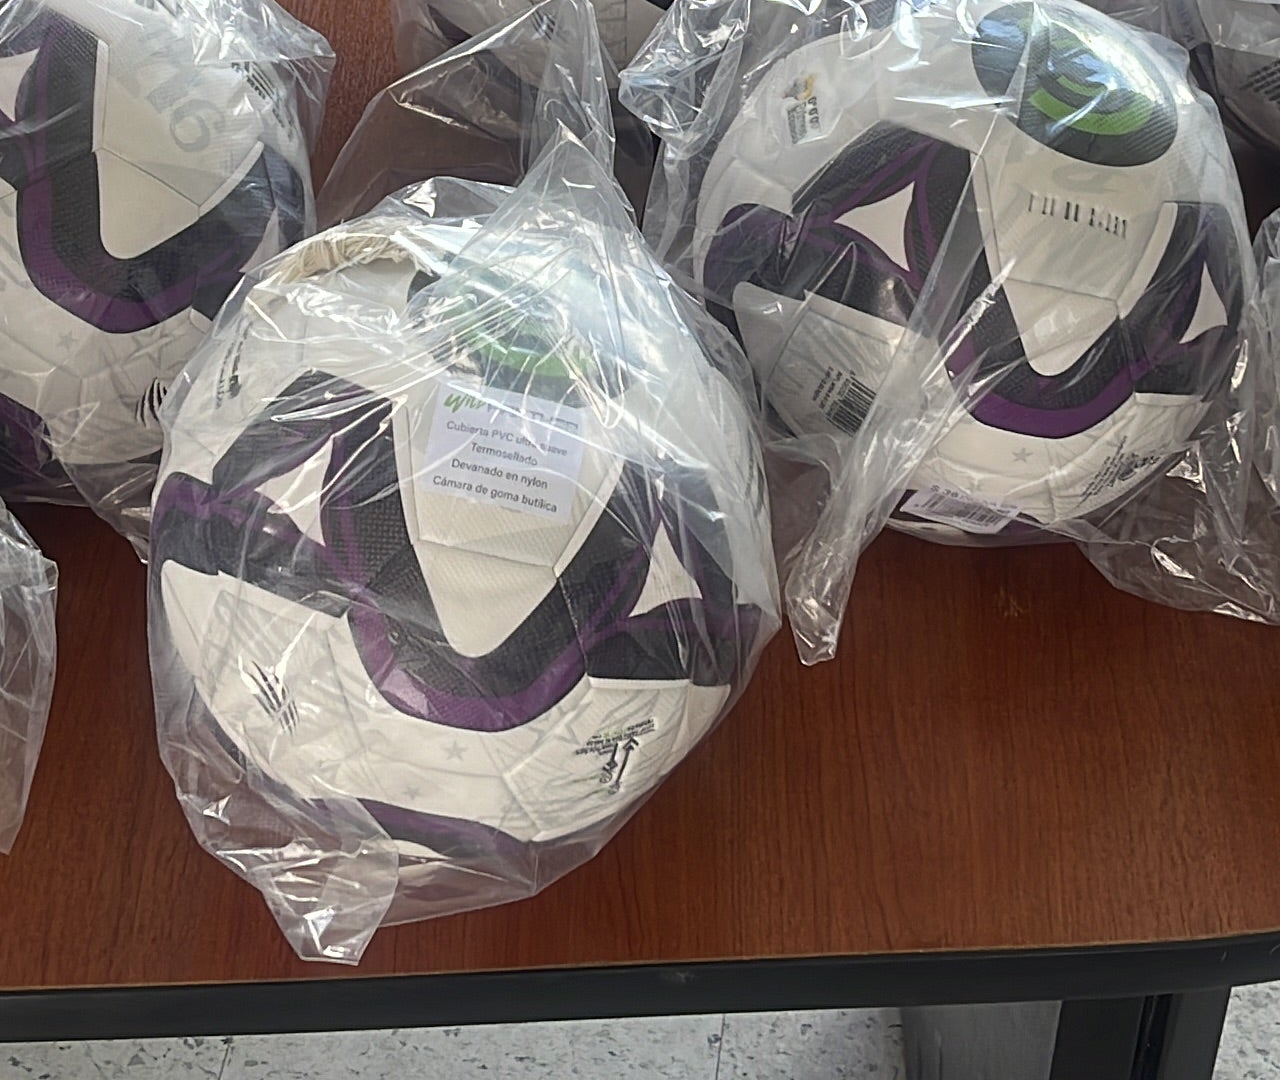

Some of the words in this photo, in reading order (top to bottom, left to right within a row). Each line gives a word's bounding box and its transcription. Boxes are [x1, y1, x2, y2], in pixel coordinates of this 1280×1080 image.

[446, 420, 489, 438] Cubierta
[491, 430, 514, 442] PVC
[472, 442, 538, 466] Termosellado
[451, 458, 503, 478] Devanado
[505, 471, 519, 482] en
[520, 473, 548, 490] nylon
[433, 475, 473, 492] Cámara
[475, 484, 488, 495] de
[490, 489, 519, 503] goma
[521, 494, 557, 513] butílica
